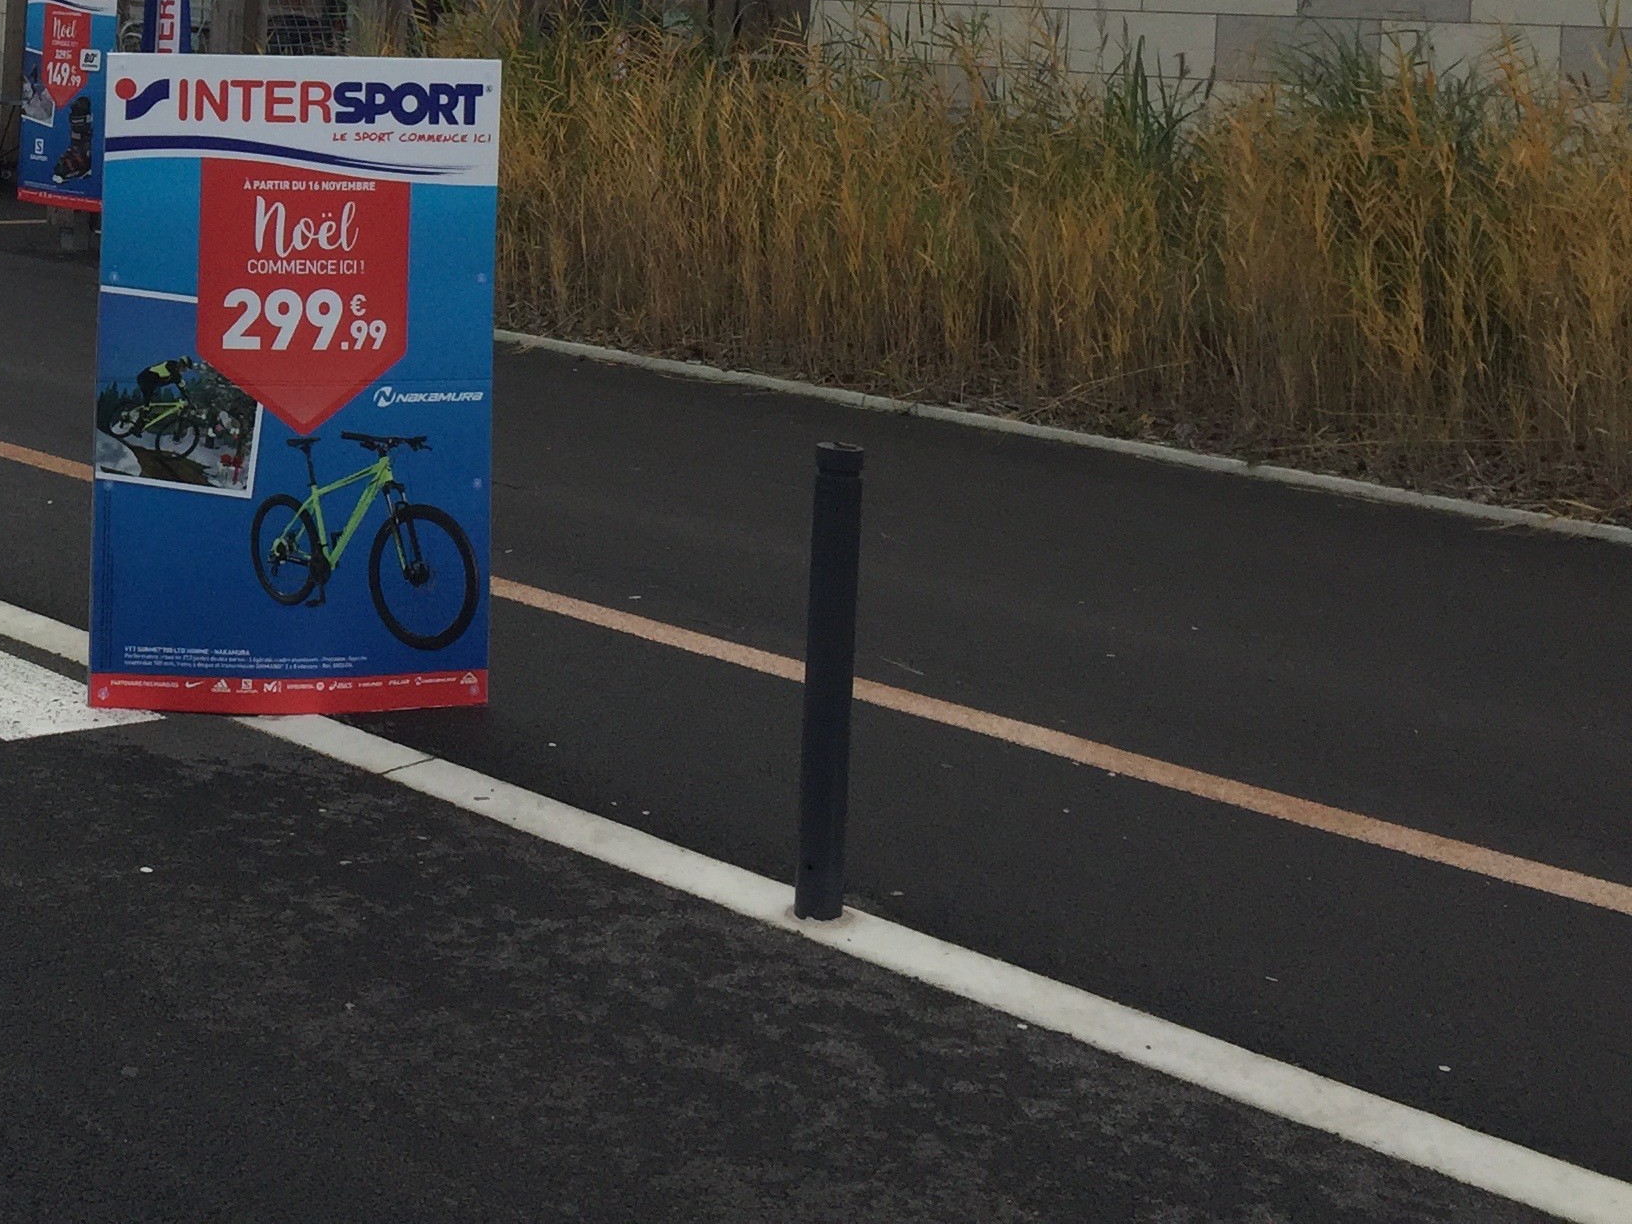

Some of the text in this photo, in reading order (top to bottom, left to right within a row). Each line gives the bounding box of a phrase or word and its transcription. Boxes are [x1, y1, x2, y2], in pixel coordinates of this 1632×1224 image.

[177, 78, 484, 127] INTERSPORT
[332, 131, 493, 144] LE SPORT COMMENCE ICI
[253, 180, 291, 190] PARTIR
[292, 180, 307, 191] DU
[308, 180, 320, 191] 16
[321, 180, 377, 192] NOVEMBRE
[254, 194, 360, 259] Noël
[247, 259, 338, 275] COMMENCE
[339, 259, 358, 275] ICI
